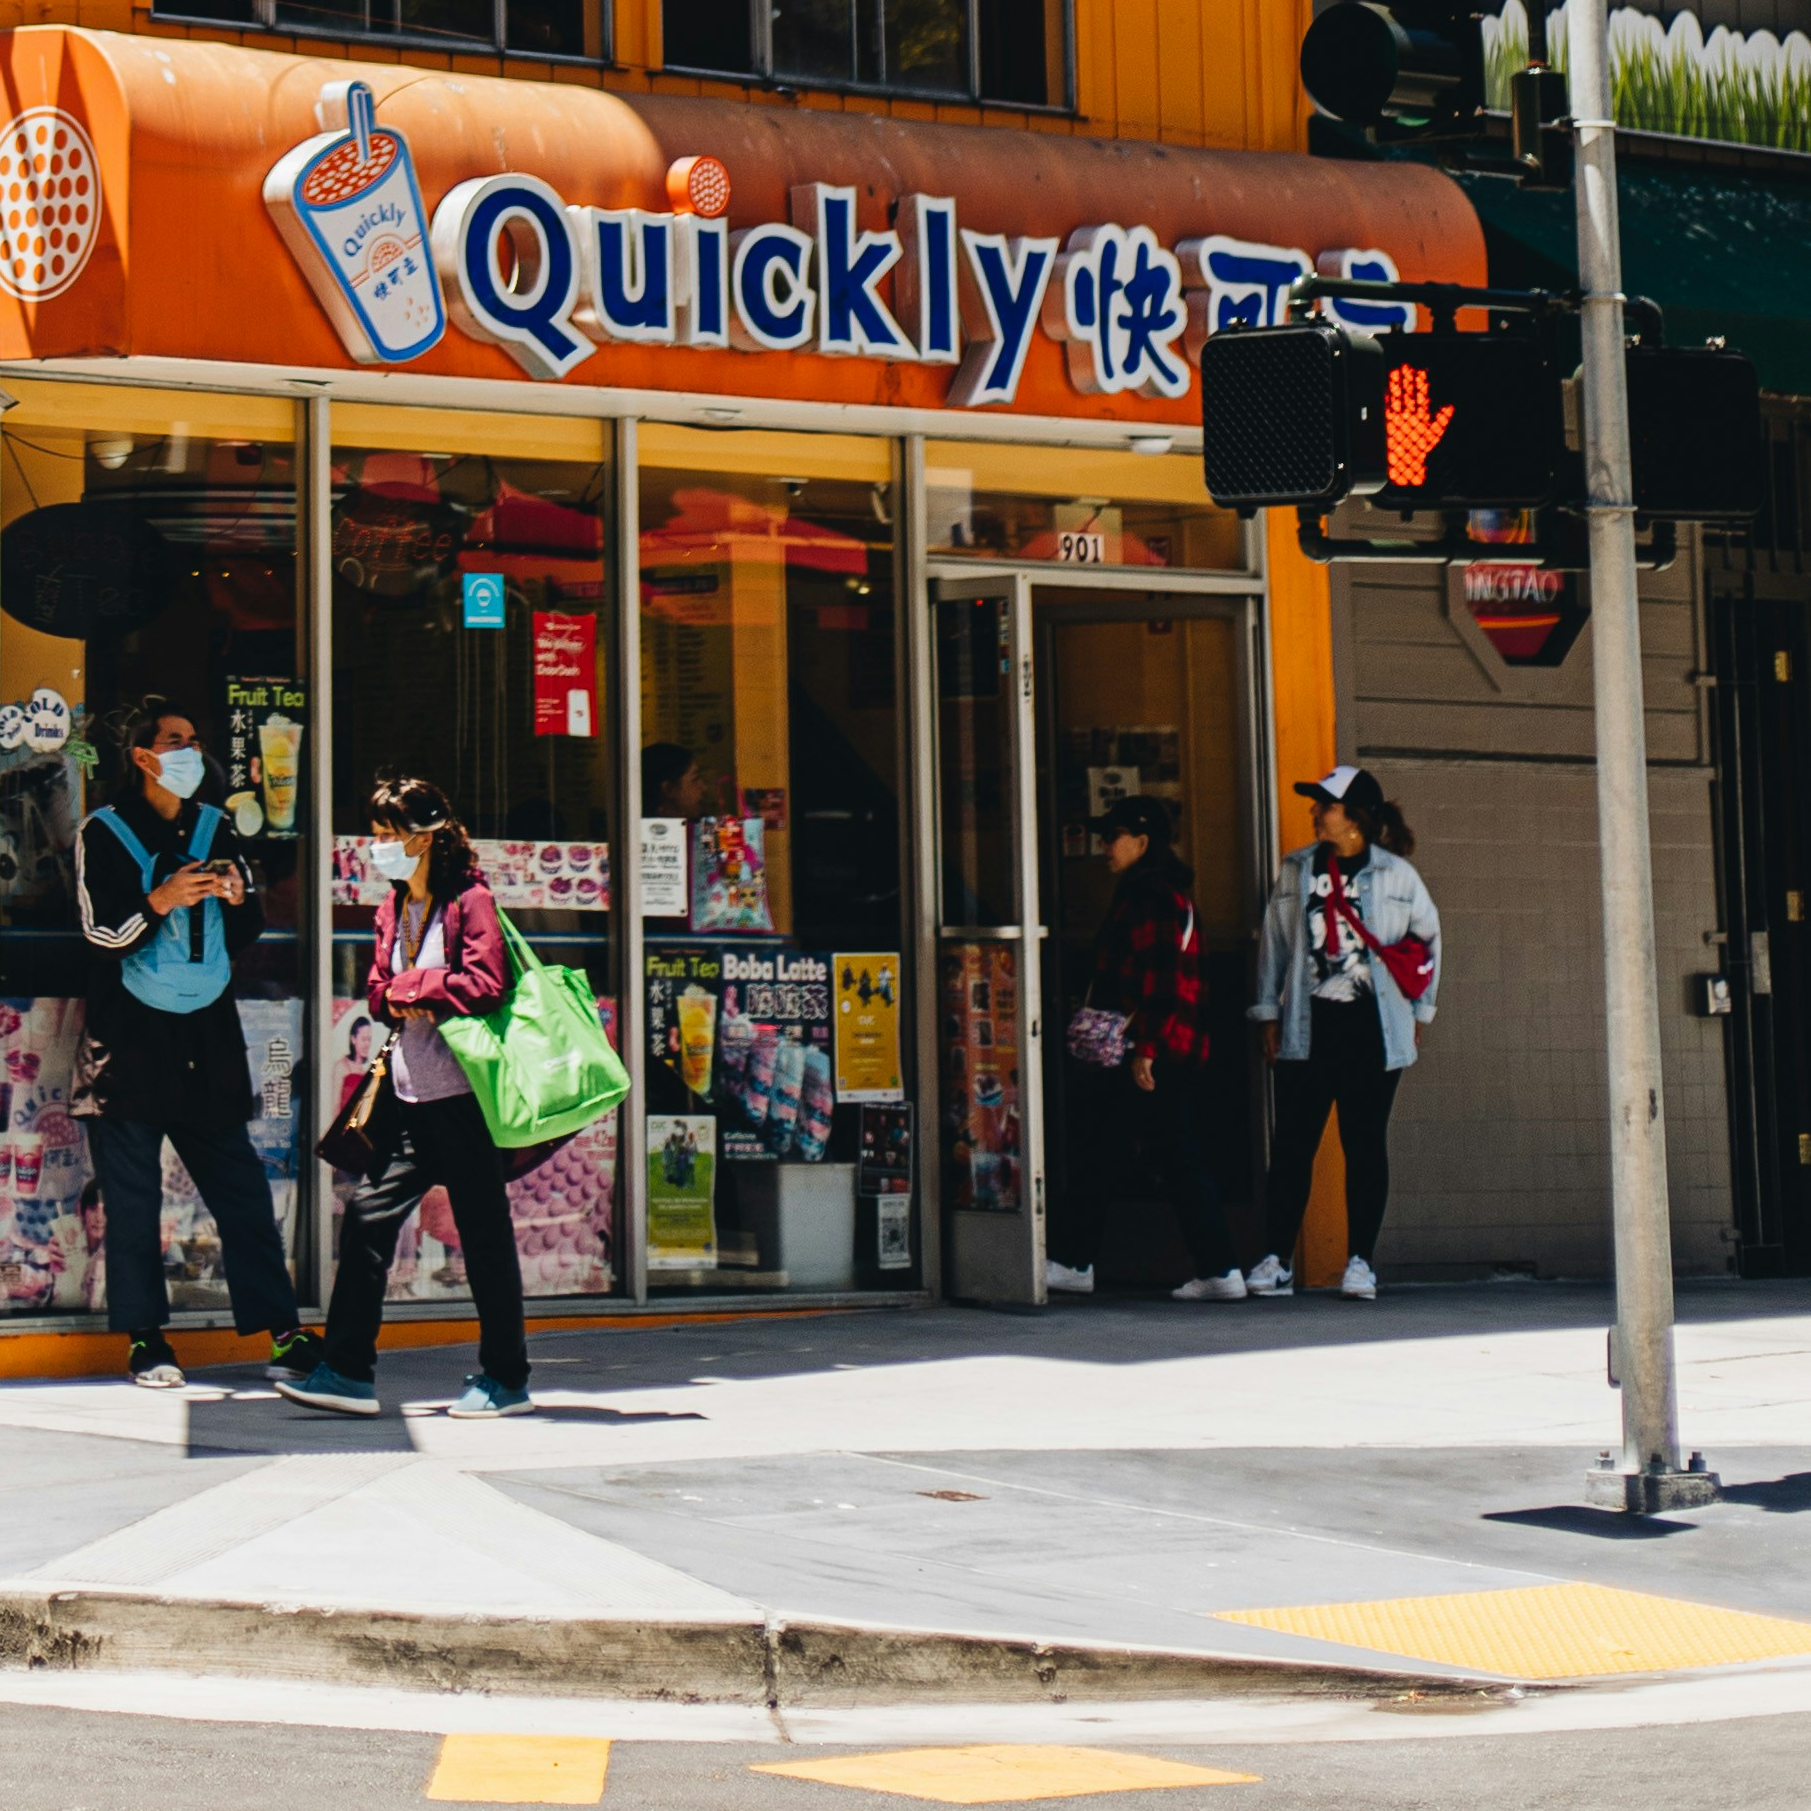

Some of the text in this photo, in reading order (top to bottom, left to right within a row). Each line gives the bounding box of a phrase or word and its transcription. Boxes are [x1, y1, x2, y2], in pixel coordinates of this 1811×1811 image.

[344, 202, 406, 257] Quickly
[451, 155, 1059, 407] Quickly
[333, 516, 453, 563] Coffee
[1062, 534, 1100, 564] 901
[227, 684, 305, 708] Fruit Tea
[34, 722, 64, 739] Drinks
[230, 708, 247, 789] 水果茶
[646, 956, 721, 978] Fruit Tea
[722, 953, 828, 981] Boba Latte
[649, 979, 667, 1058] 水果茶
[259, 1036, 293, 1120] 烏龍
